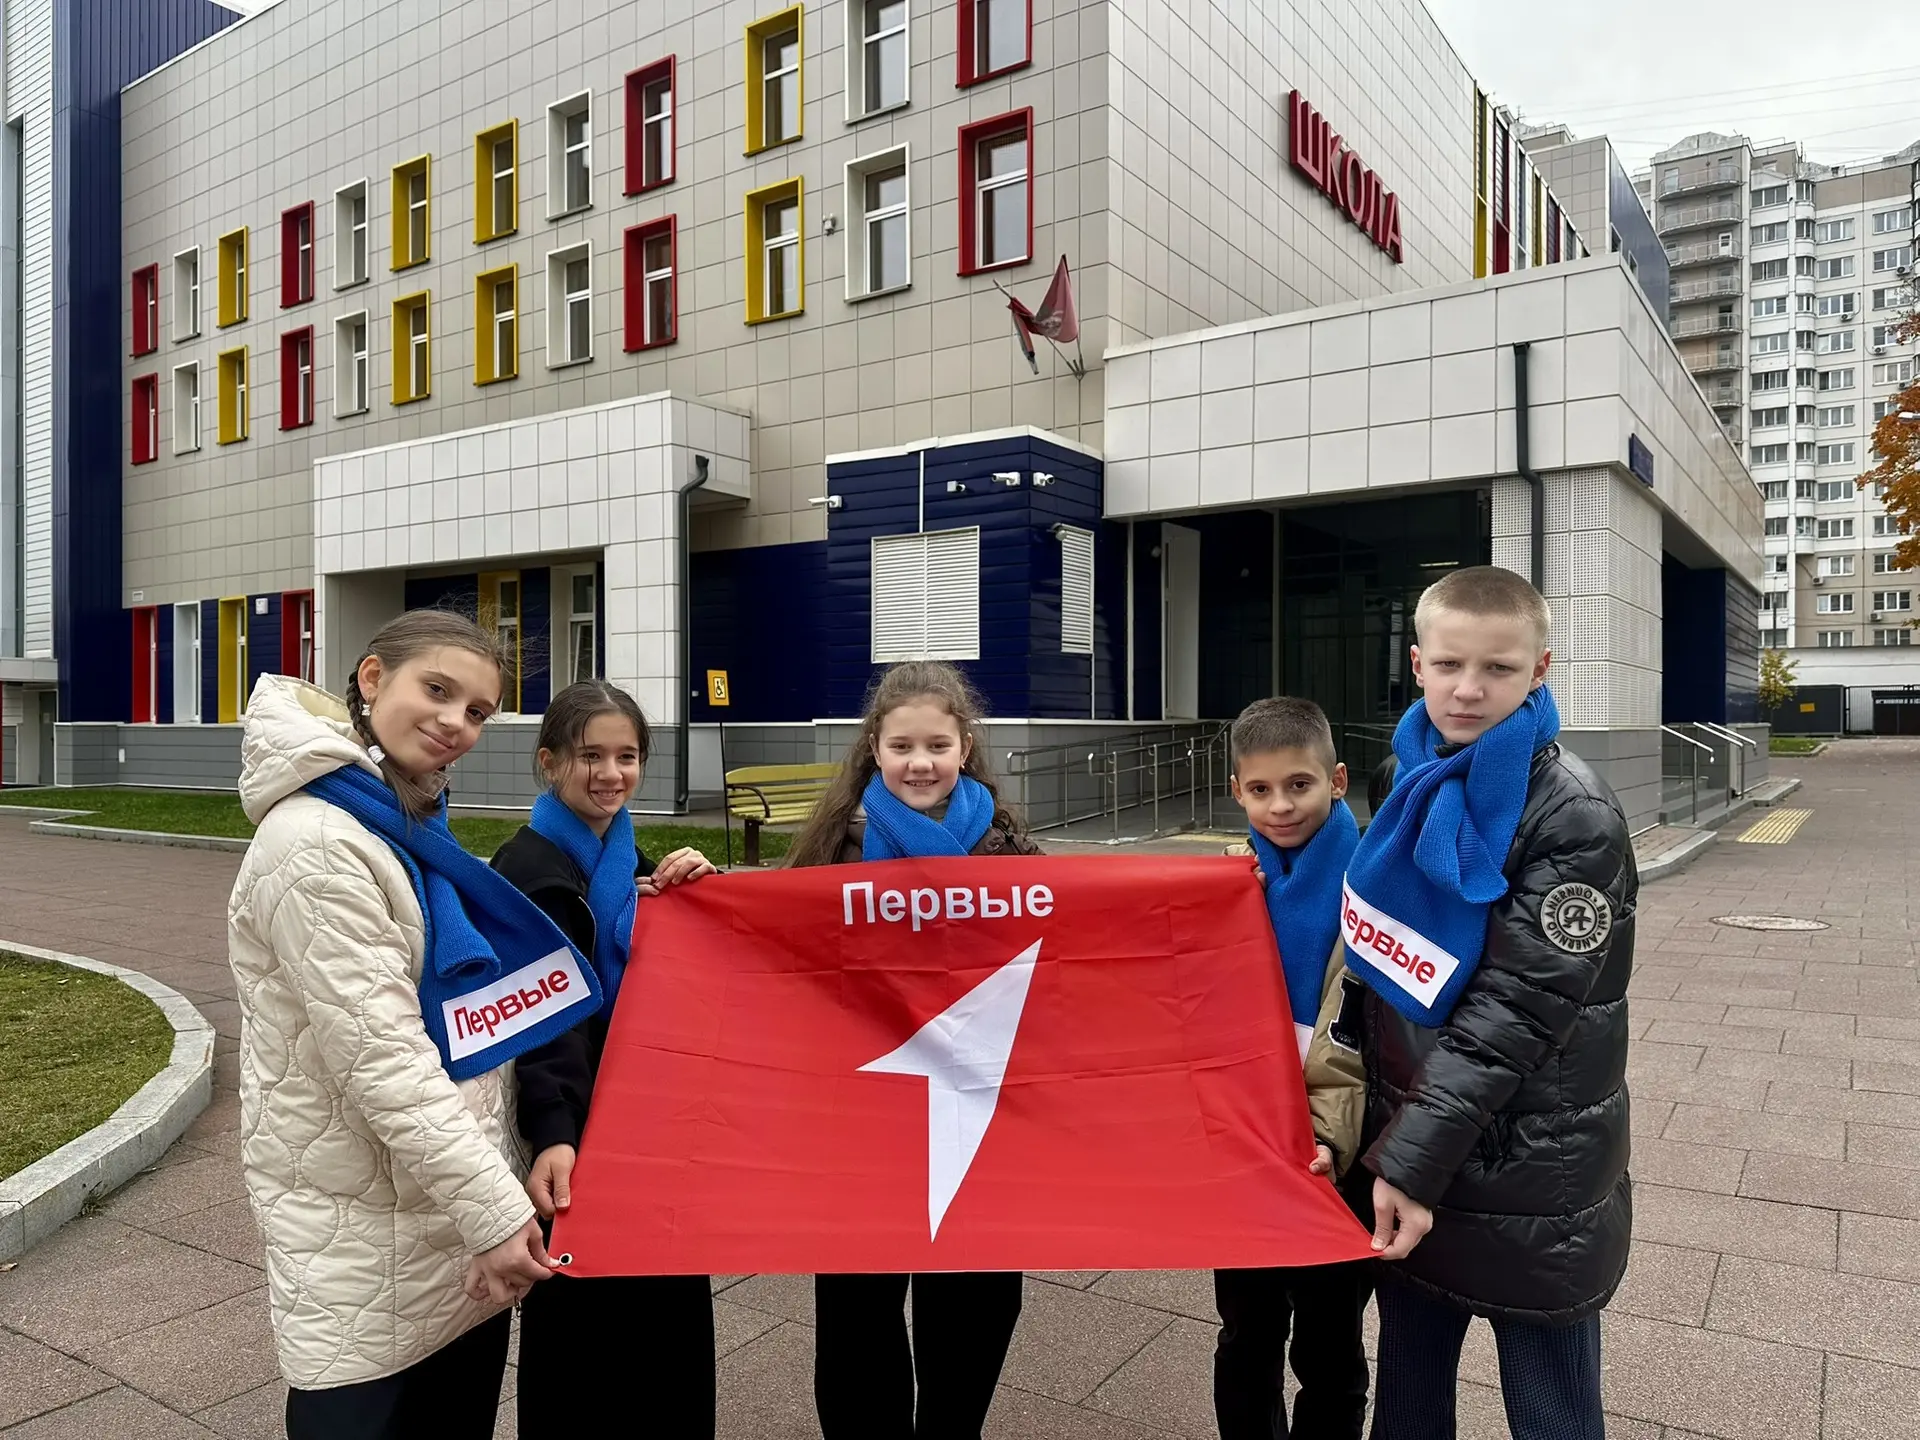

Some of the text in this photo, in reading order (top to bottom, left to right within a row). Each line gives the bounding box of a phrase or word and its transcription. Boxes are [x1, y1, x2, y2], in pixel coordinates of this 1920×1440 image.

[1289, 89, 1403, 263] ШКОЛА
[842, 881, 1054, 932] Первые
[453, 969, 570, 1040] Первые
